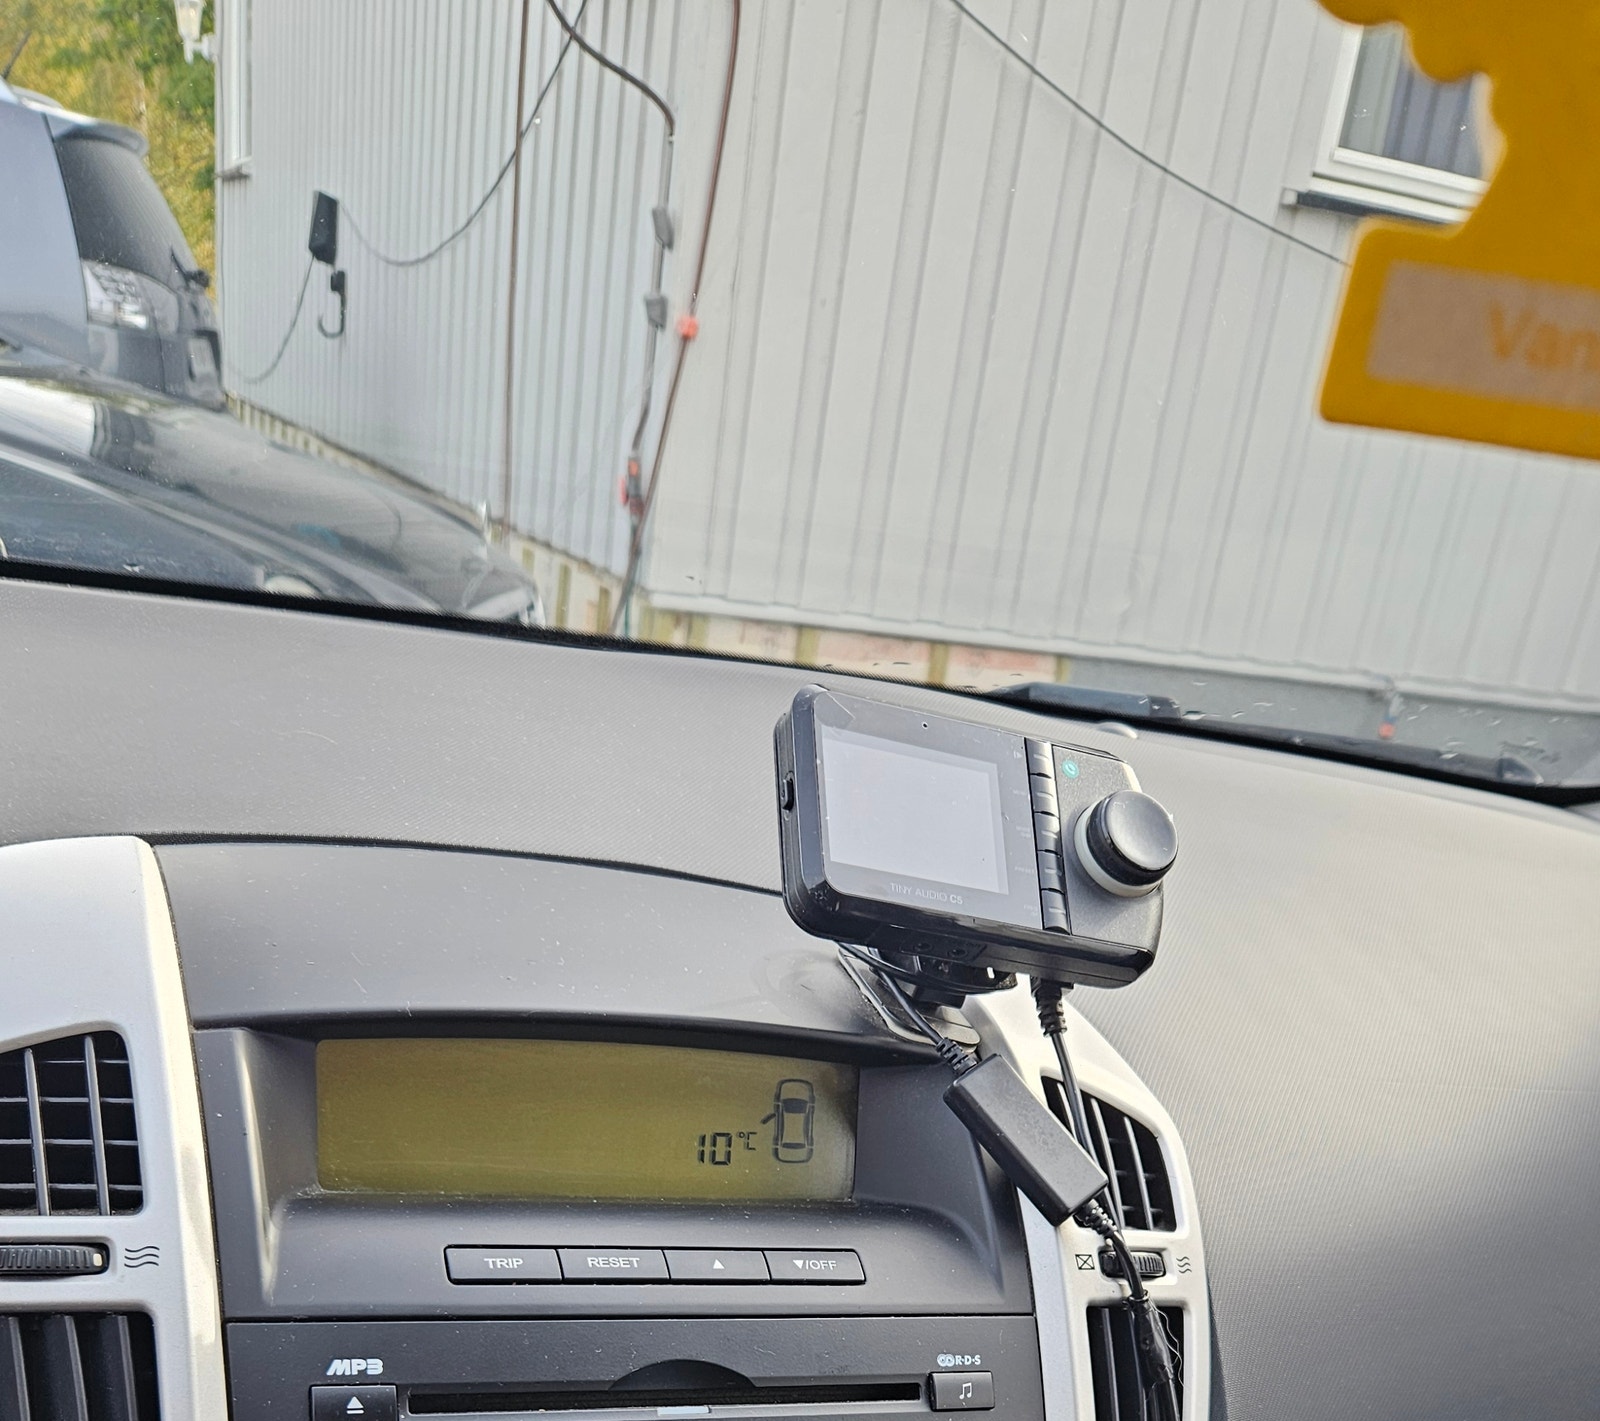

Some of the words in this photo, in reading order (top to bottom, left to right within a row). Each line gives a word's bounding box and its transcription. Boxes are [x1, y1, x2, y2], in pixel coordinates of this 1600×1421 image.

[890, 882, 913, 896] TINY
[915, 888, 948, 903] AUDIO
[484, 1257, 524, 1270] TRIP
[587, 1256, 641, 1269] RESET
[326, 1357, 384, 1376] MP3
